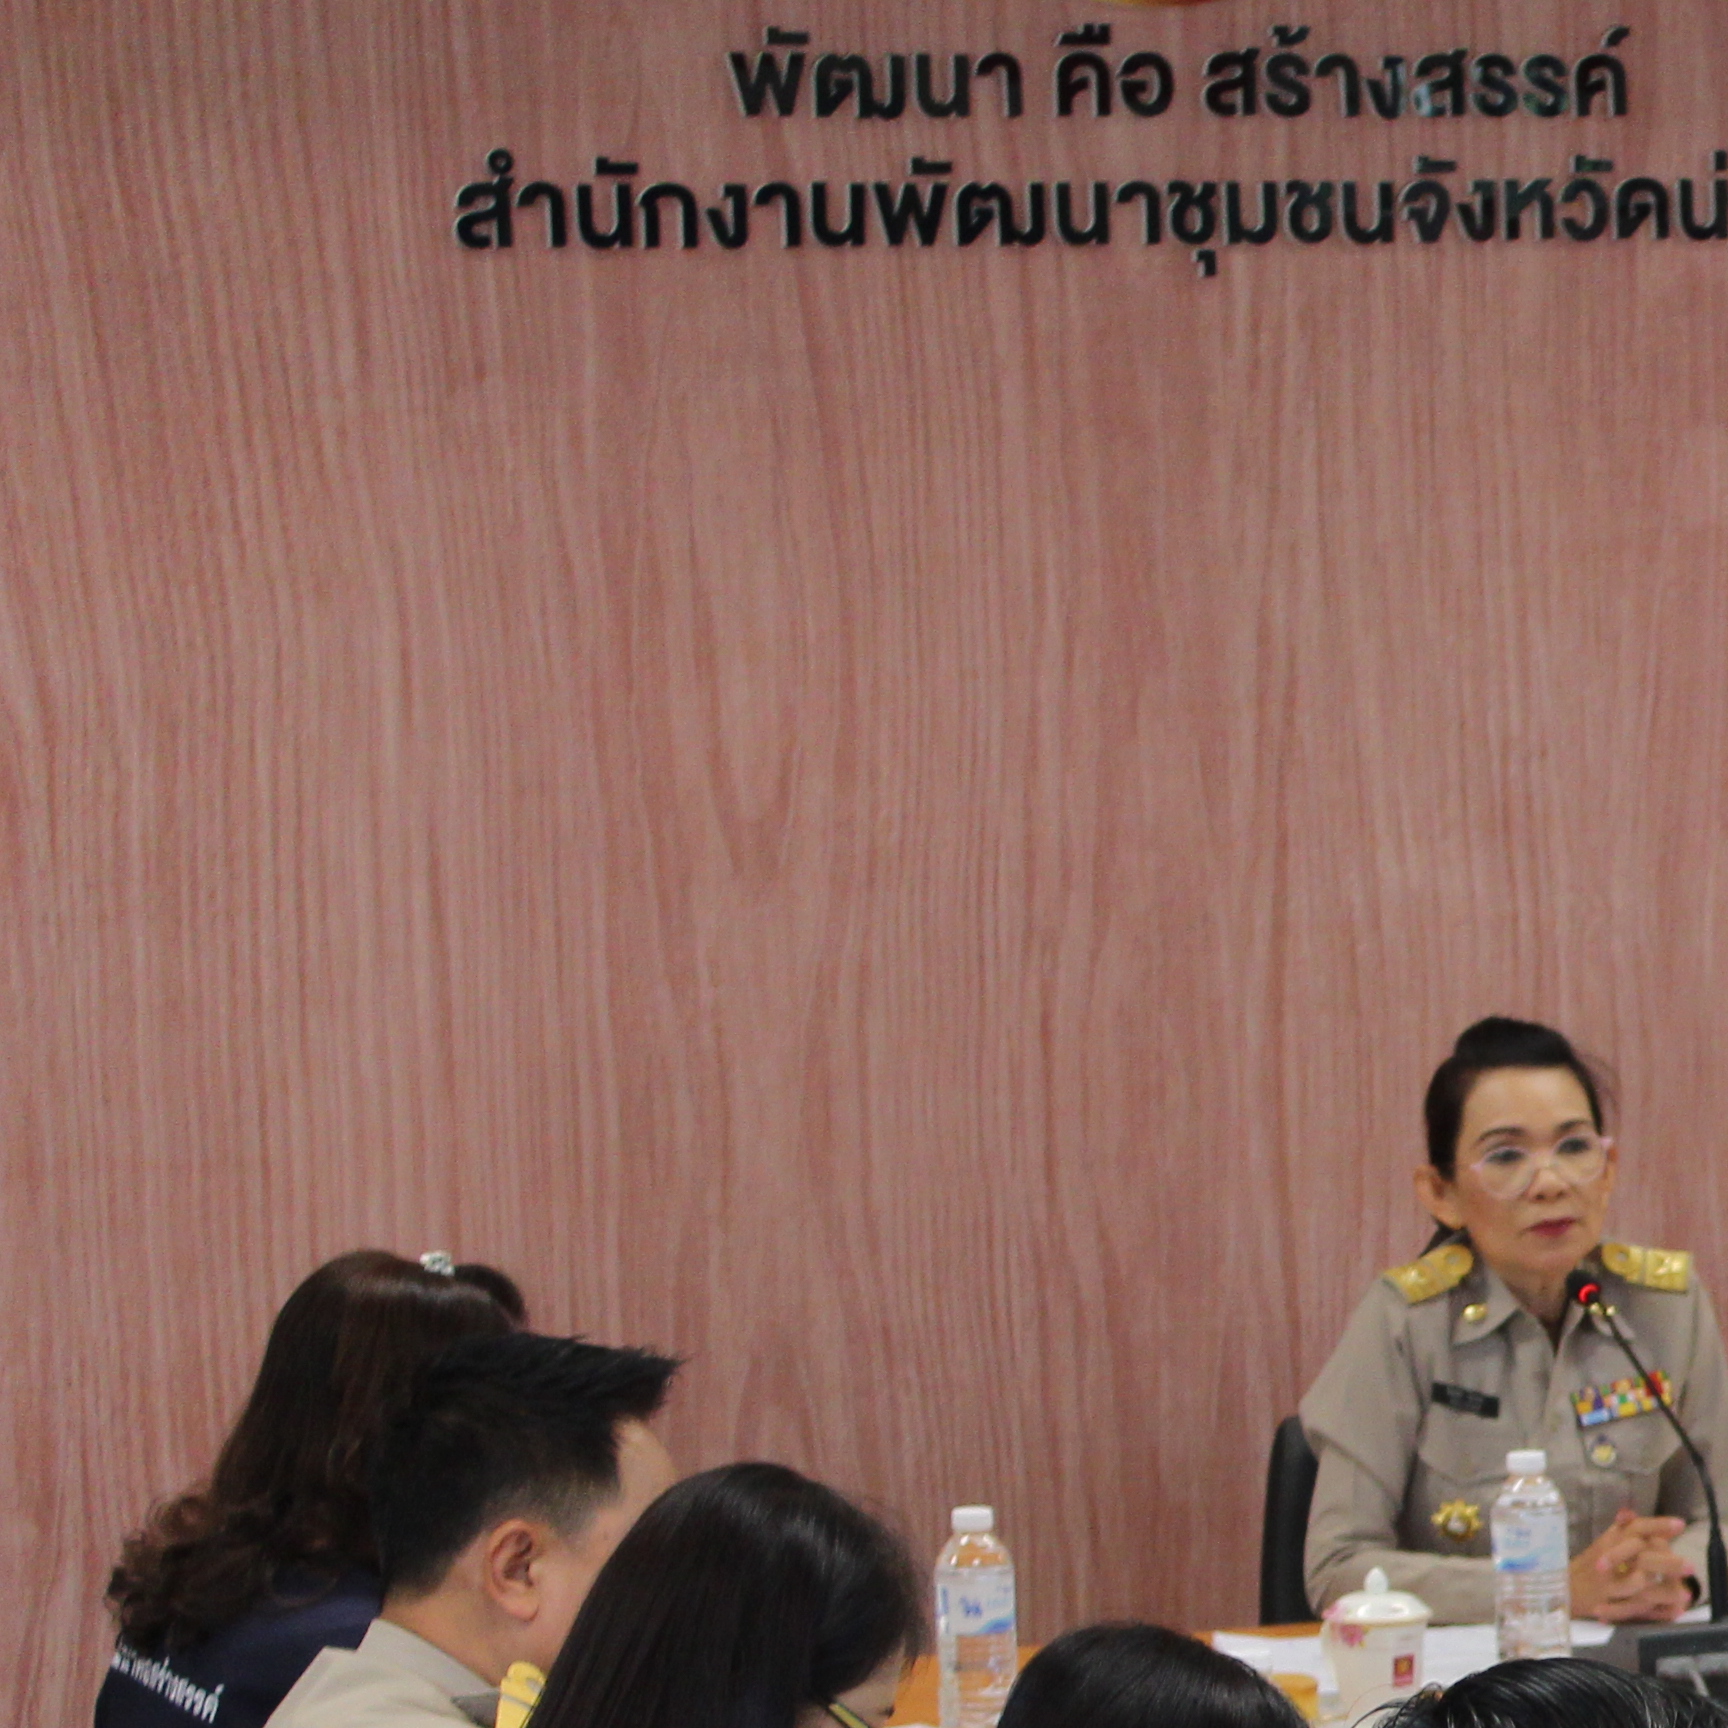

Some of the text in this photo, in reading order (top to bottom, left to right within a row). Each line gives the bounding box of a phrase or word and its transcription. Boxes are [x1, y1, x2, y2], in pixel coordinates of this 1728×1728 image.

[728, 24, 1630, 119] พัฒนา คือ สร้างสรรค์
